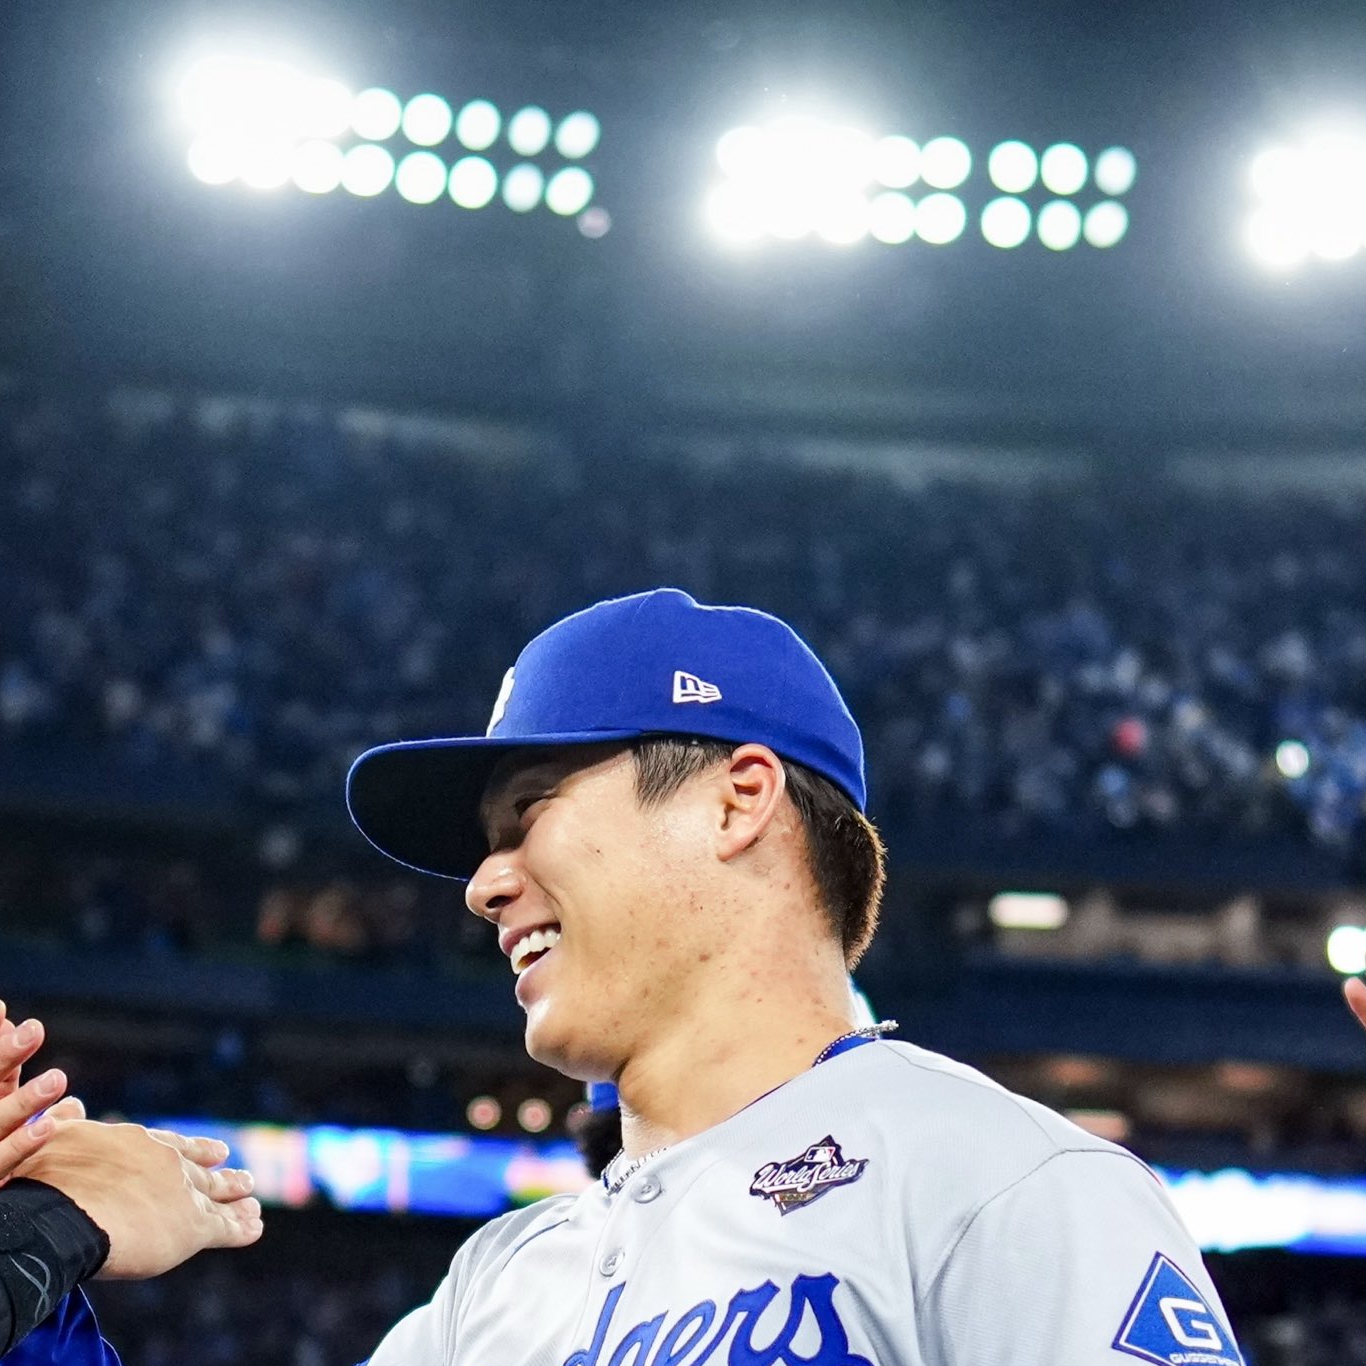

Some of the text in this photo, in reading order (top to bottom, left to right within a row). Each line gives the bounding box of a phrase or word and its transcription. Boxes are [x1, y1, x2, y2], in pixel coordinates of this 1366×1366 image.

[752, 1160, 861, 1192] World Series
[1159, 1297, 1223, 1351] G
